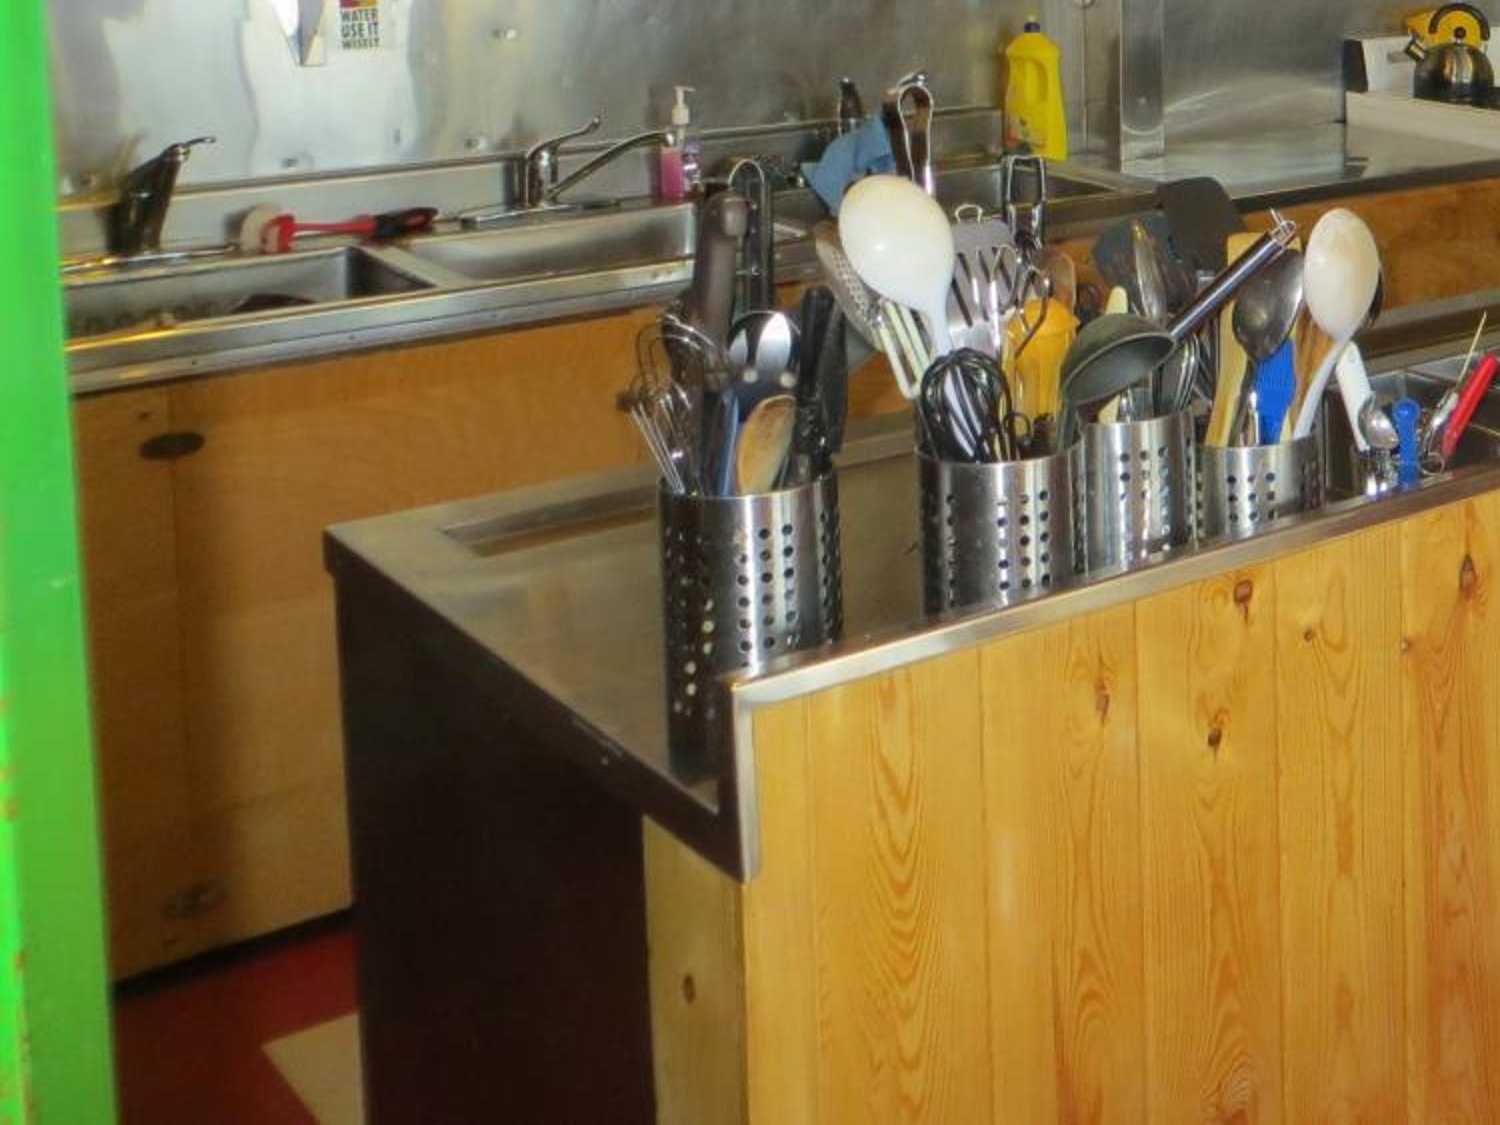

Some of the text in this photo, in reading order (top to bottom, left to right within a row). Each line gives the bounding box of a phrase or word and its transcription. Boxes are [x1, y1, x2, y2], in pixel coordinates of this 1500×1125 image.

[340, 9, 378, 22] WATER
[341, 22, 379, 38] USE IT
[342, 37, 380, 50] WISELY
